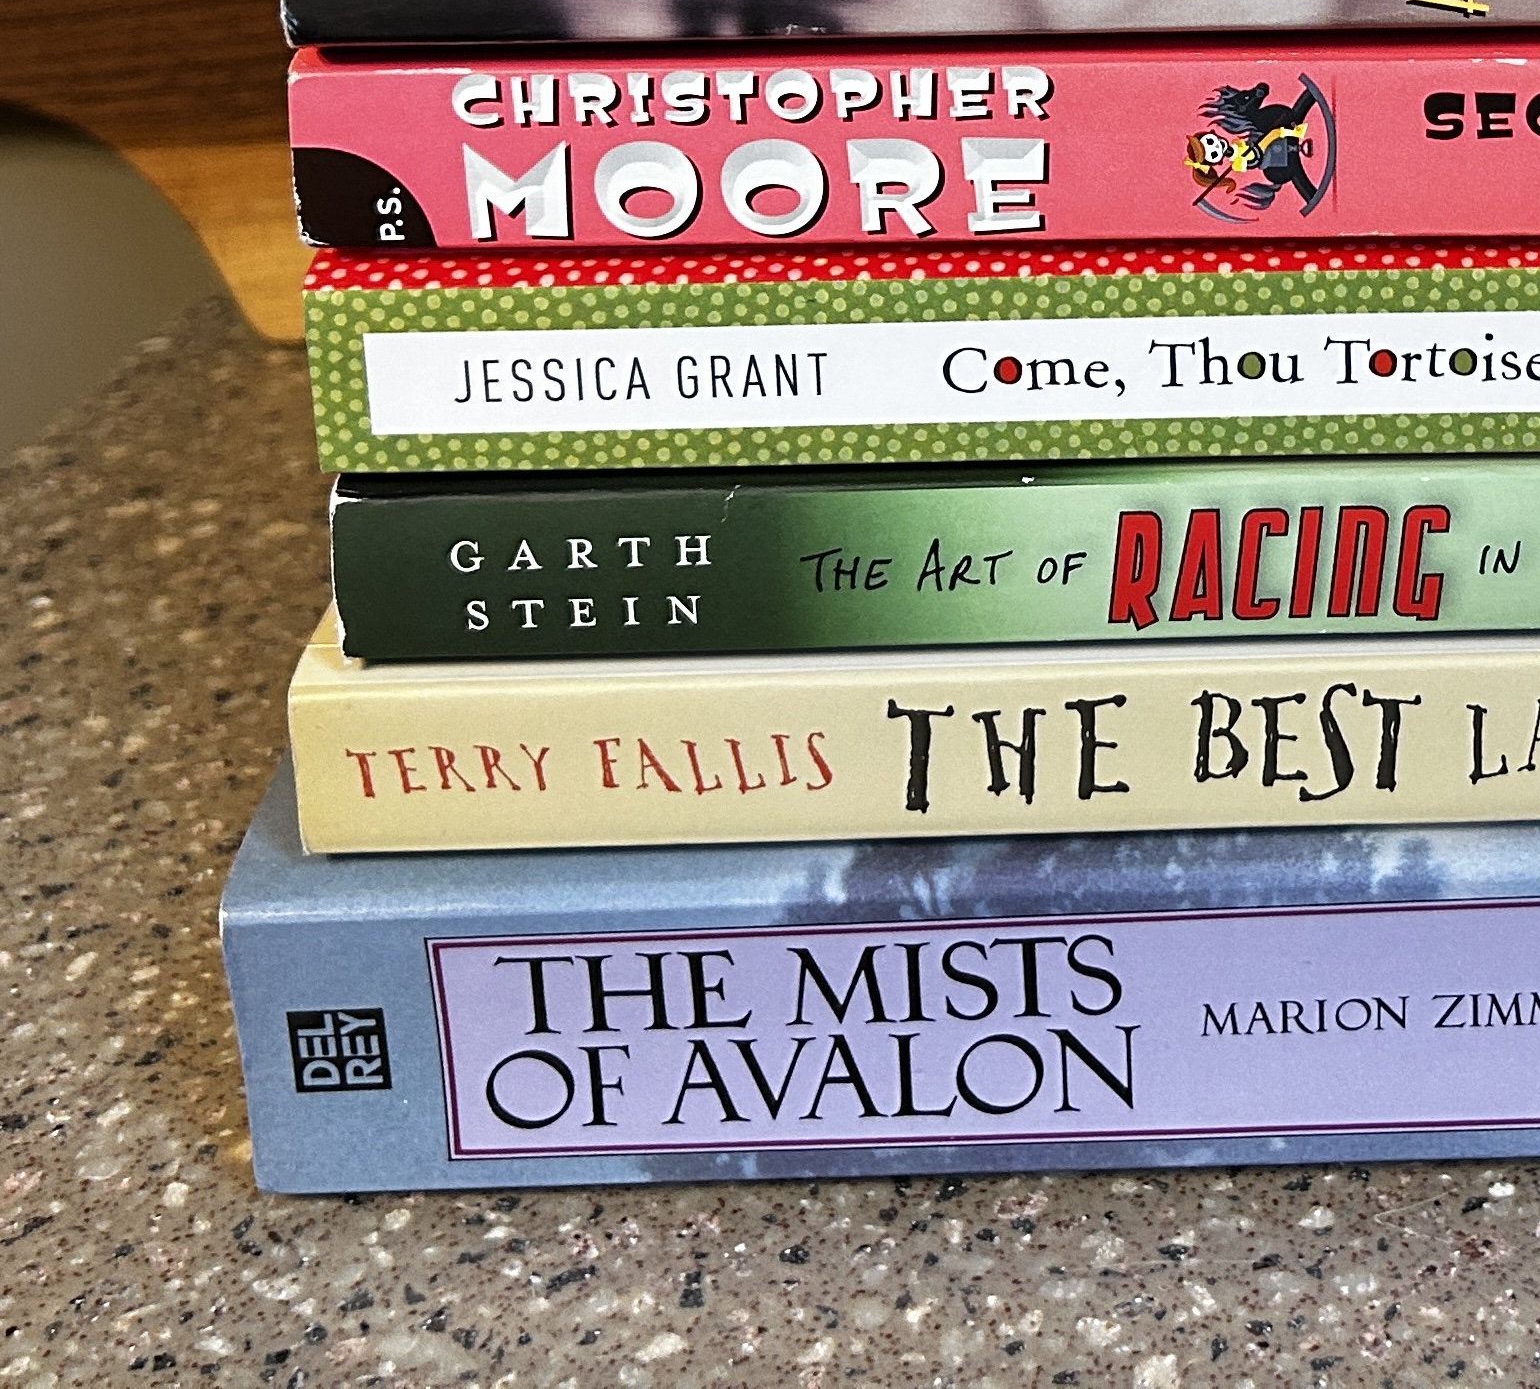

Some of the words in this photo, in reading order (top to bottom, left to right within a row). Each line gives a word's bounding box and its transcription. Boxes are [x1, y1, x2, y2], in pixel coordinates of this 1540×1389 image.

[451, 66, 1054, 130] CHRISTOPHER
[379, 186, 406, 242] P.S.
[462, 137, 1051, 244] MOORE
[455, 357, 652, 404] JESSICA
[677, 352, 828, 399] GRANT
[942, 346, 1125, 399] Come,
[1148, 338, 1305, 391] Thou
[450, 534, 714, 575] GARTH
[801, 548, 892, 594] THE
[917, 538, 1013, 591] ART
[1036, 550, 1089, 587] OF
[1108, 503, 1453, 632] RACING
[1478, 542, 1520, 577] IN
[466, 594, 701, 633] STEIN
[346, 744, 550, 799] TERRY
[593, 730, 835, 797] FALLIS
[887, 694, 1130, 814] THE
[1192, 683, 1422, 803] BEST
[494, 948, 753, 1035] THE
[786, 933, 1125, 1026] MISTS
[1202, 995, 1411, 1037] MARION
[302, 1012, 337, 1085] DEL
[347, 1011, 384, 1084] REY
[485, 1043, 631, 1129] OF
[662, 1025, 1140, 1127] AVALON
